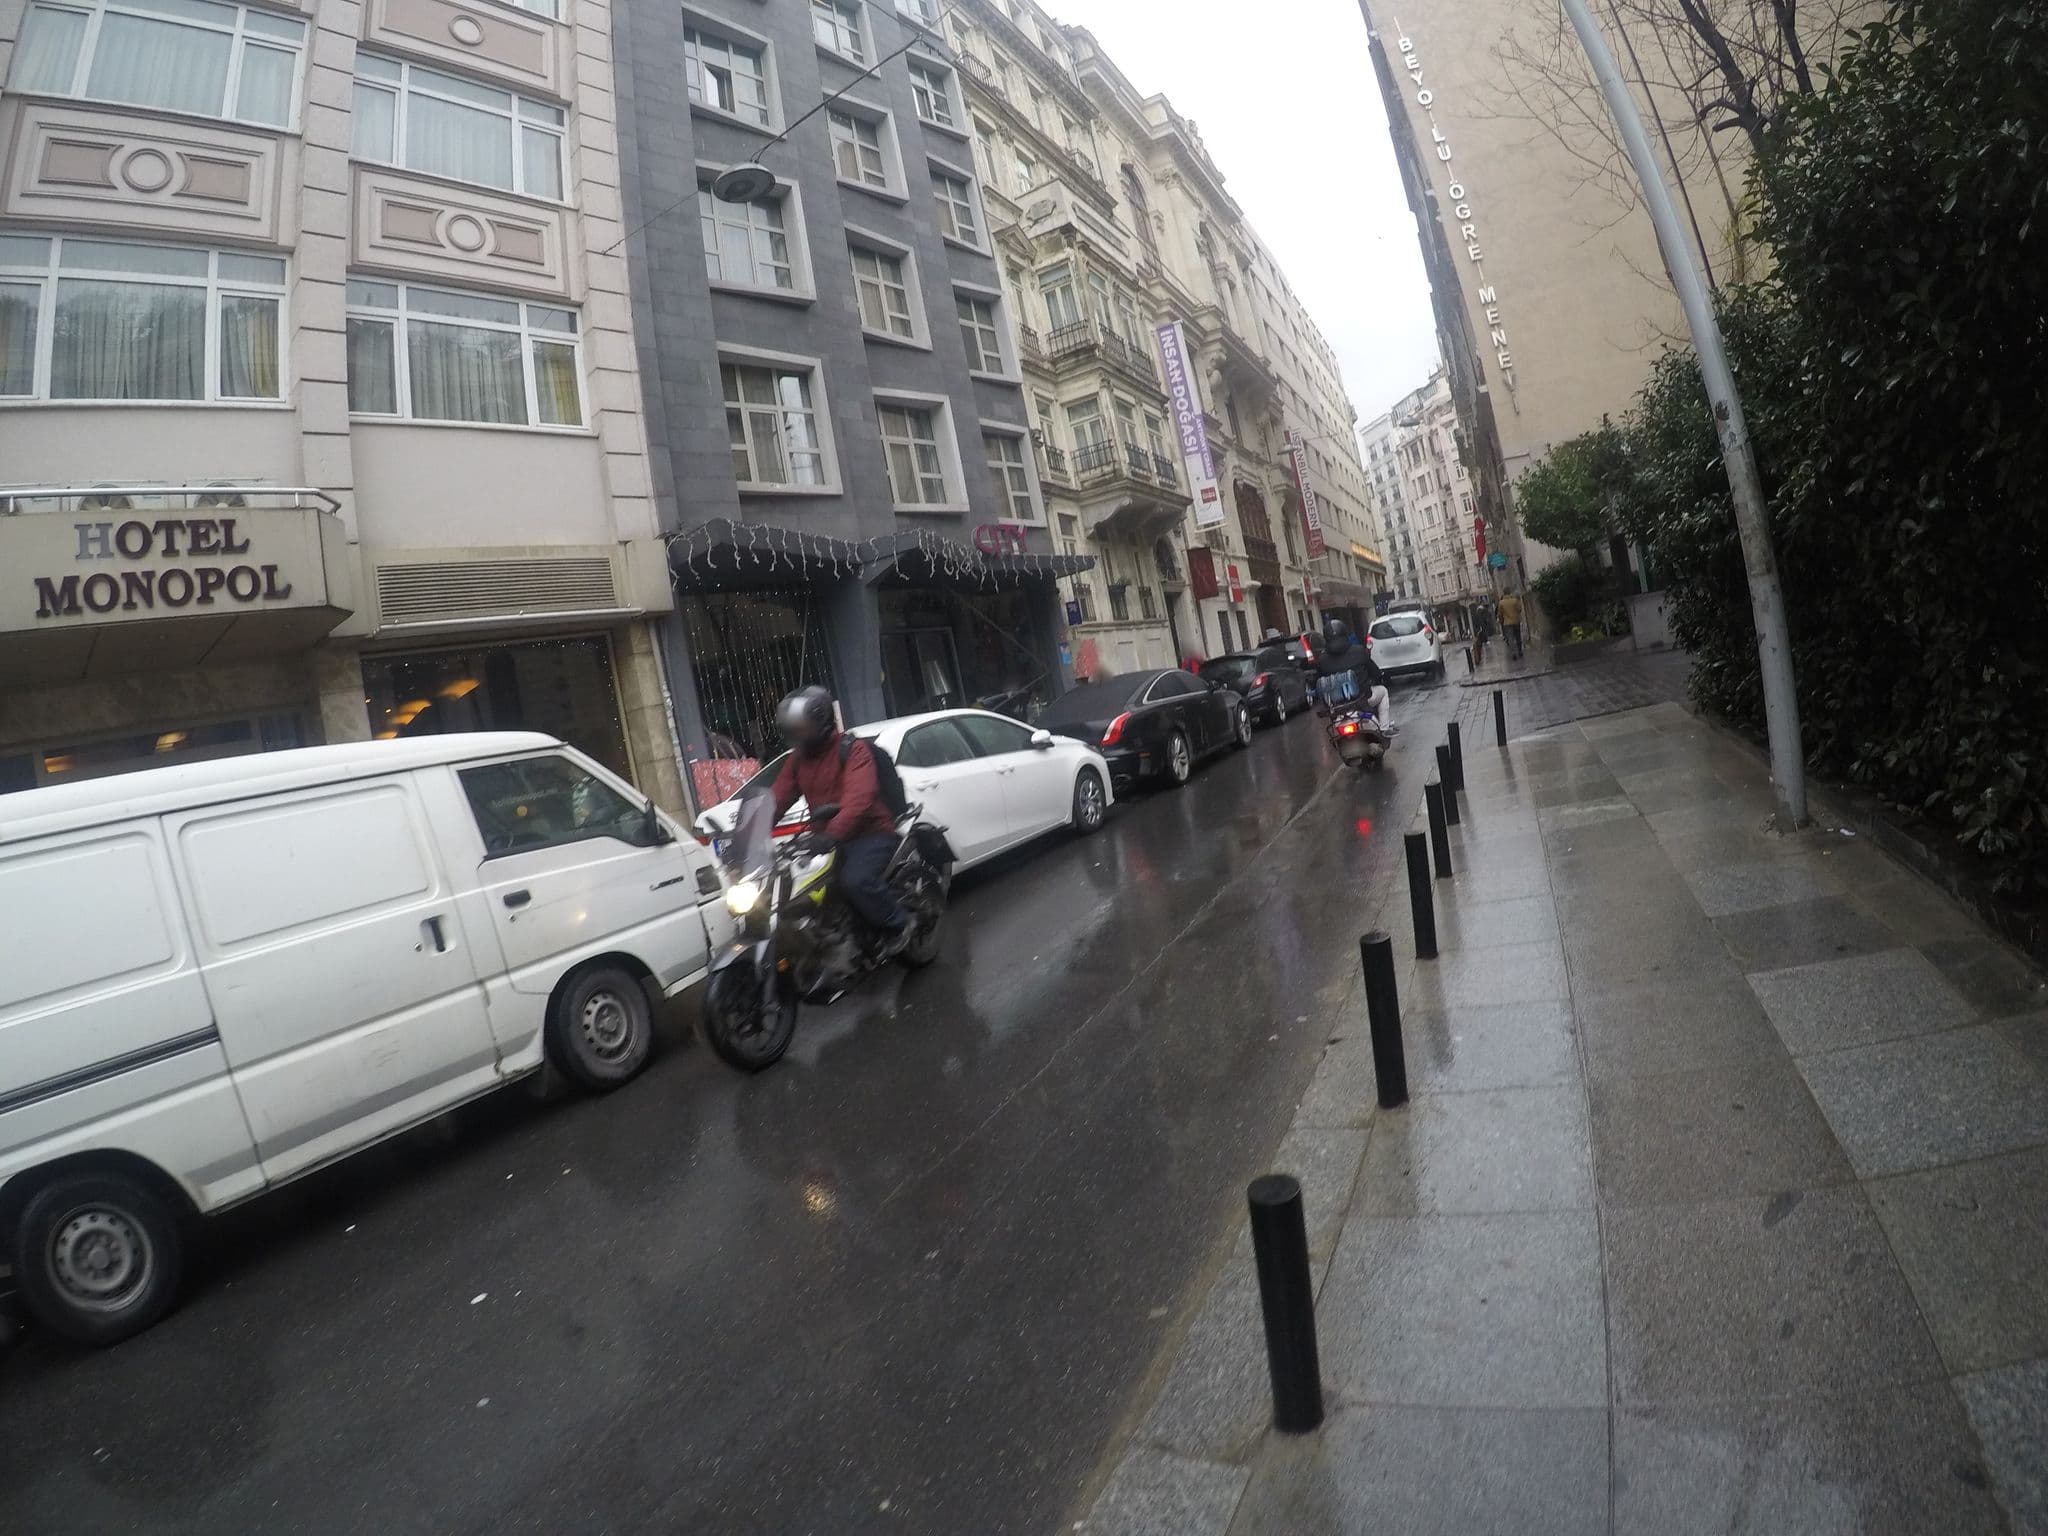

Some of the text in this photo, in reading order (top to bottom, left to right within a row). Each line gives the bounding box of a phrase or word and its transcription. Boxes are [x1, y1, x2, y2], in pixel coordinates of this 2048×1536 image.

[1160, 329, 1200, 454] İNSAN DOĞASI
[1303, 482, 1320, 529] MODERN
[74, 518, 250, 560] HOTEL
[971, 523, 1028, 557] CITY
[34, 565, 292, 618] MONOPOL
